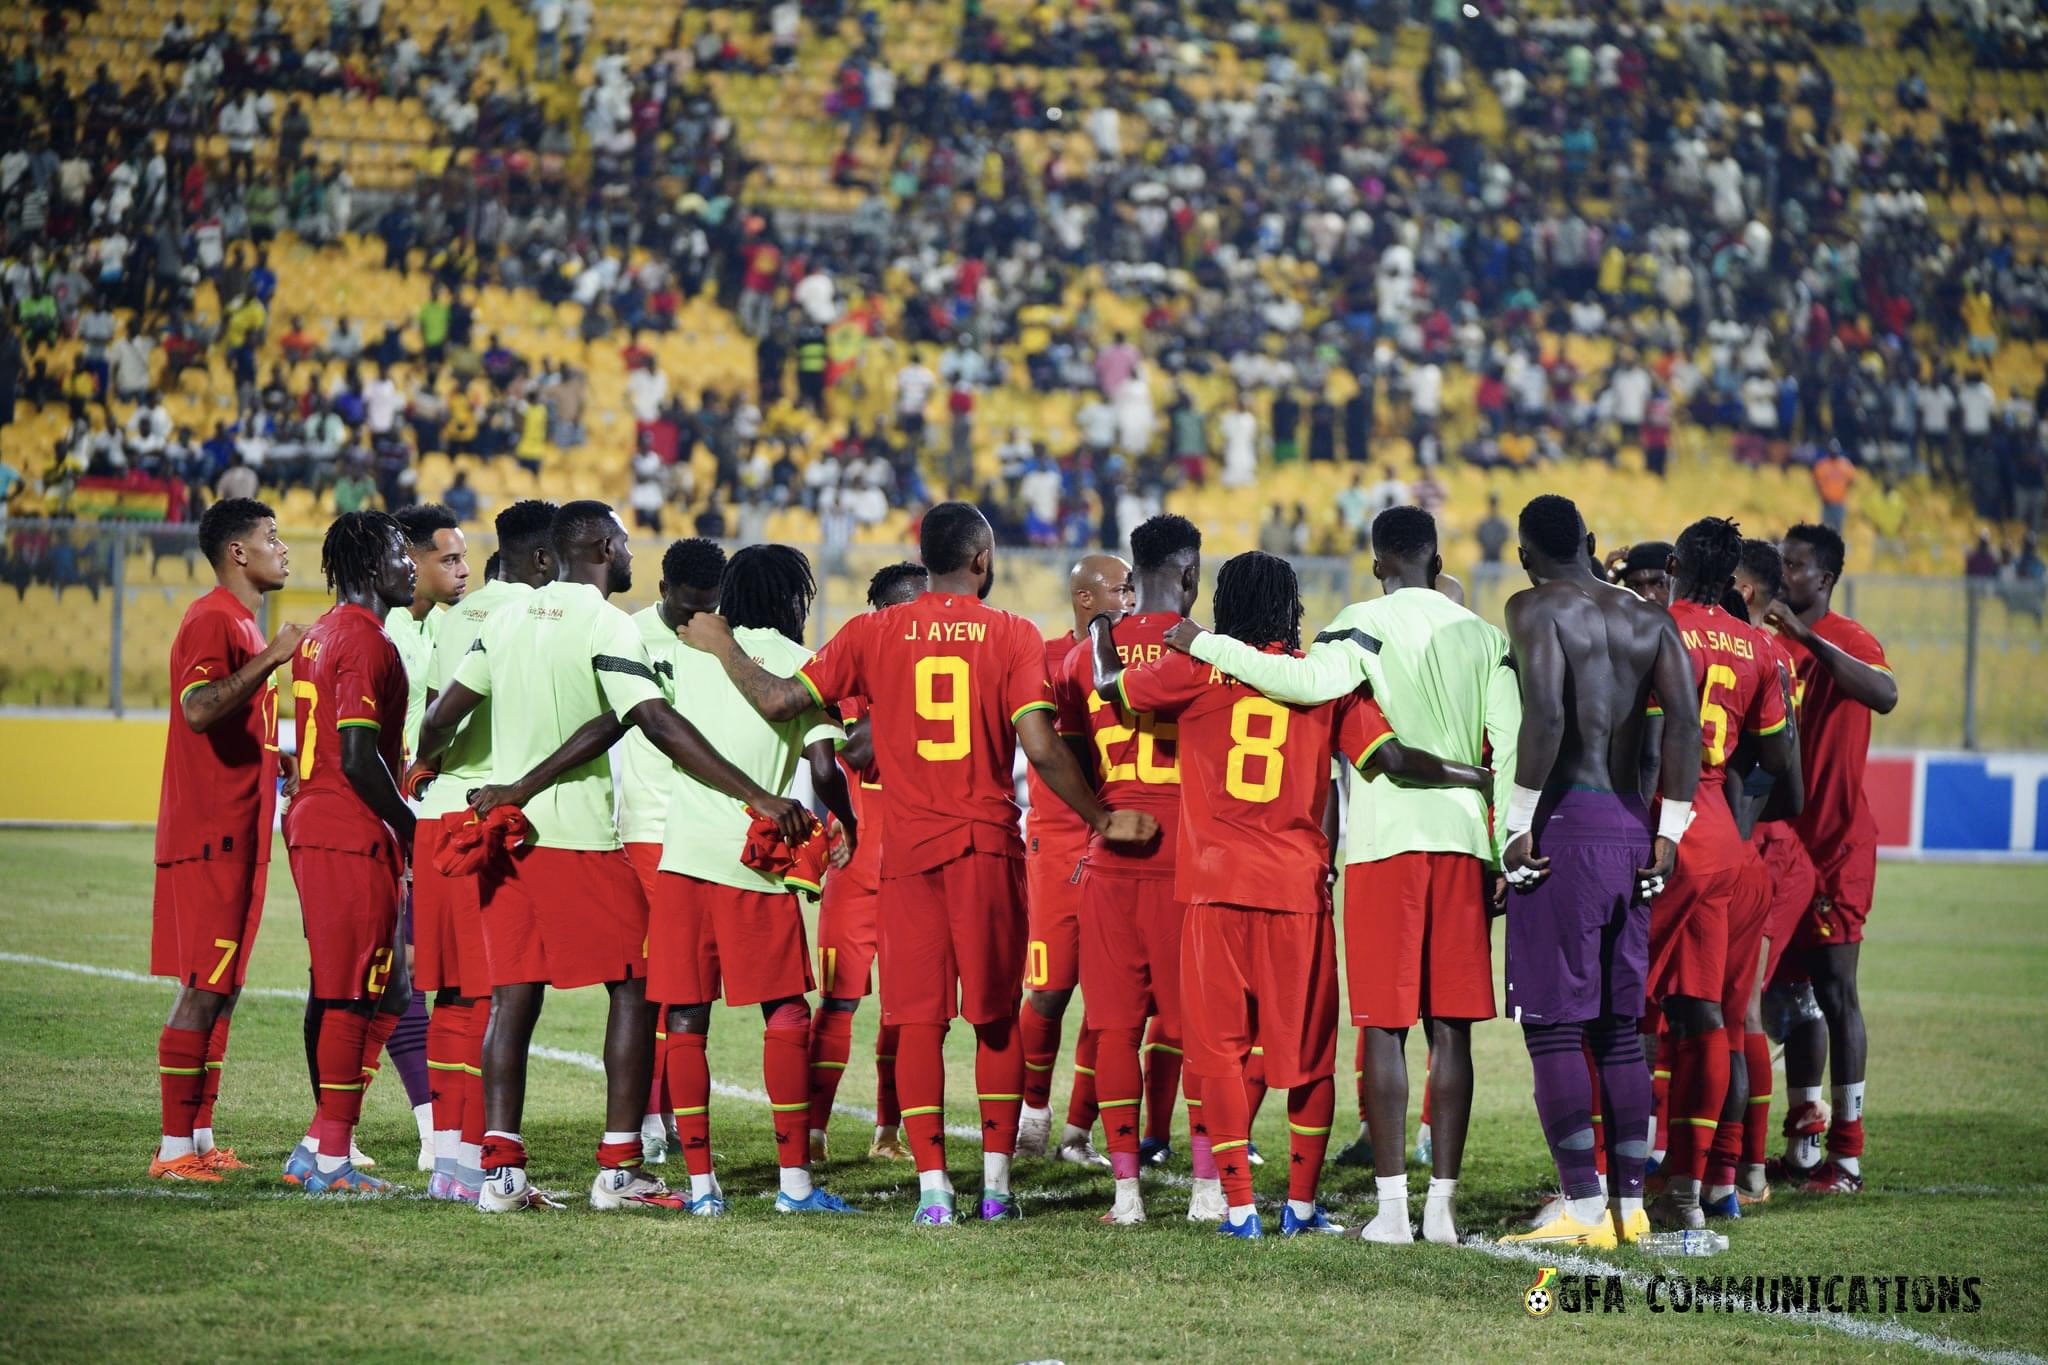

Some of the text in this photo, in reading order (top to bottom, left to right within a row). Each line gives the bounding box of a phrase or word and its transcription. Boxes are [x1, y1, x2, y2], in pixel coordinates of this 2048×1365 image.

[904, 620, 987, 643] J. AYEW
[1681, 630, 1706, 650] M.
[915, 655, 973, 761] 9
[1700, 663, 1737, 767] 6
[1225, 695, 1290, 804] 8
[207, 938, 238, 985] 7
